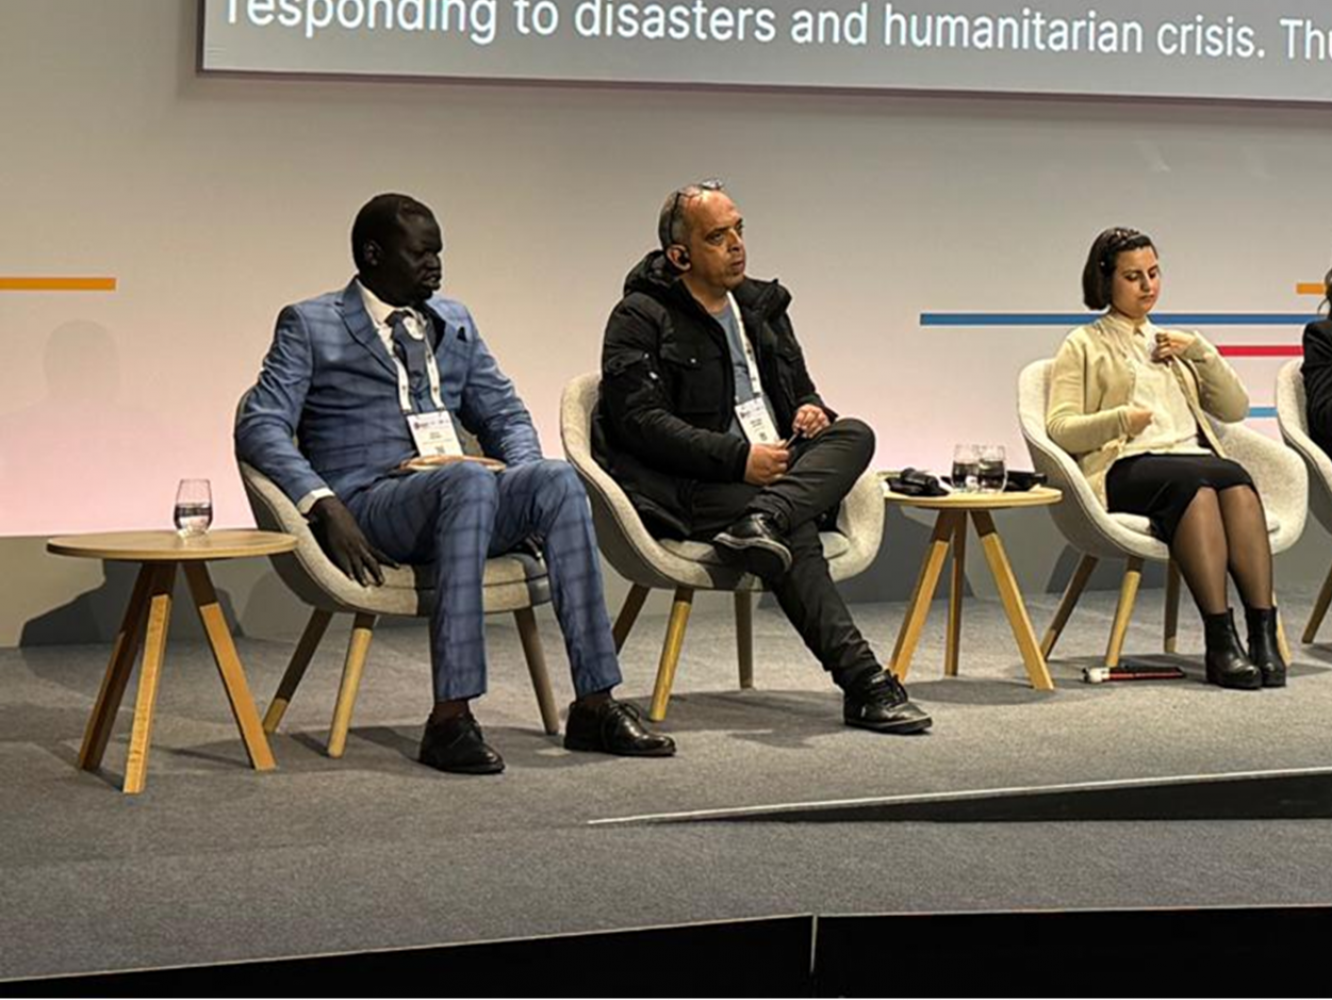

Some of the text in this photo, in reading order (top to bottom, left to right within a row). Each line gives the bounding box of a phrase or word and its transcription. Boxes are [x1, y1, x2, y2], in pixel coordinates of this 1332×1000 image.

[790, 2, 867, 46] and
[884, 3, 1143, 54] humanitarian
[1156, 14, 1266, 59] crisis.
